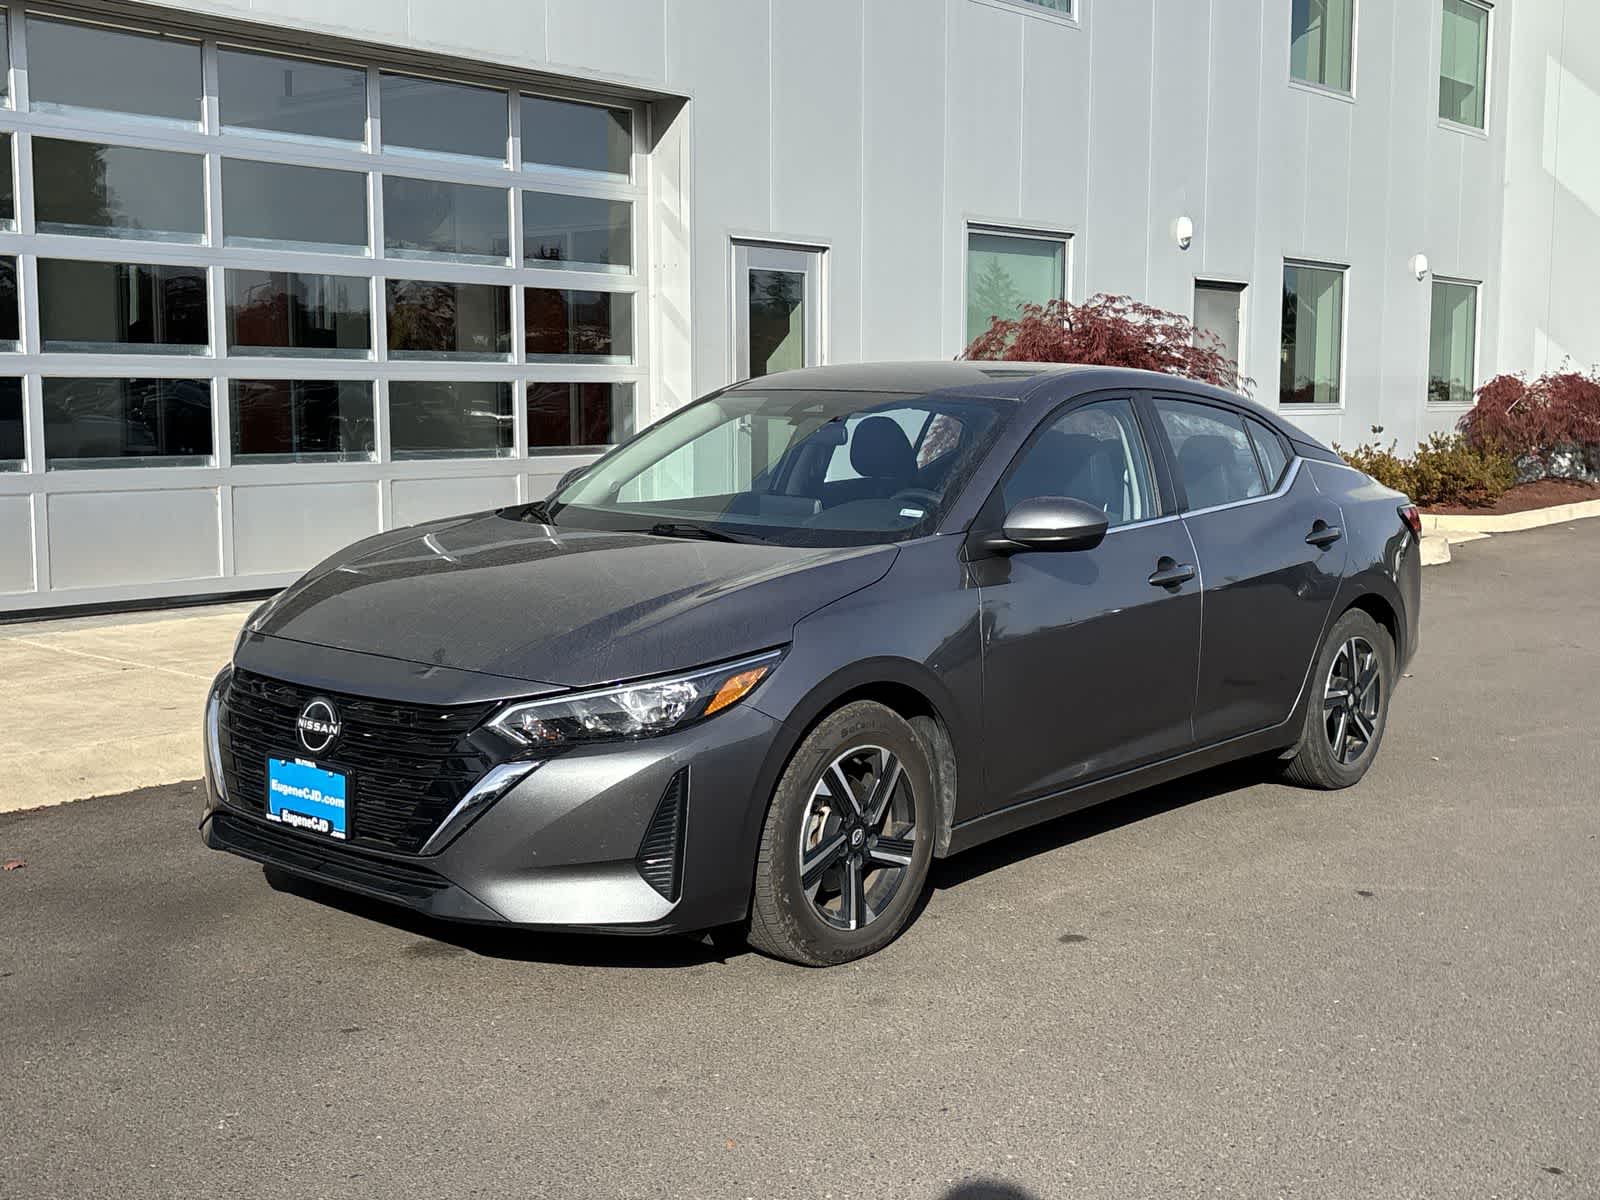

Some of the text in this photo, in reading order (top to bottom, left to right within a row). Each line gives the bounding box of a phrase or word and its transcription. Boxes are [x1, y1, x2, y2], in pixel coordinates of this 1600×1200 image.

[298, 719, 338, 735] NISSAN
[271, 779, 345, 808] EugeneCJD.com
[282, 809, 329, 833] EugeneCJD
